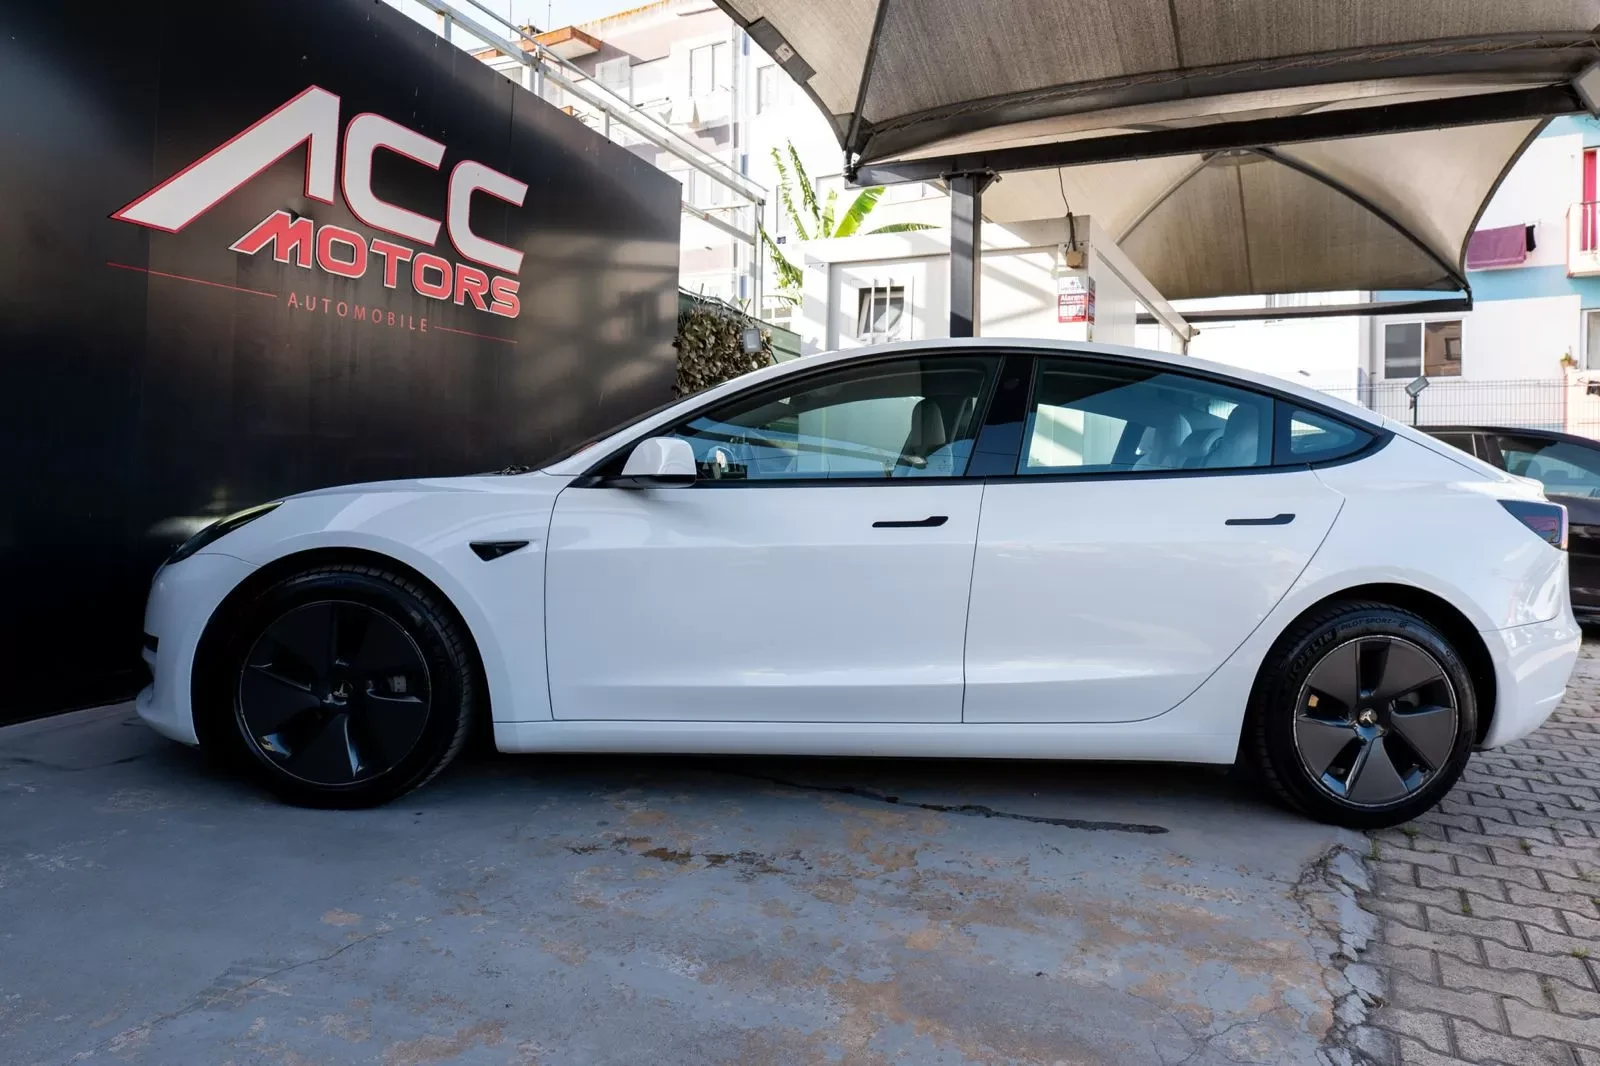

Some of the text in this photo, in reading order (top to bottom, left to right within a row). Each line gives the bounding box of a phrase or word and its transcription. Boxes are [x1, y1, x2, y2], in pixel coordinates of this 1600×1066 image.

[110, 85, 528, 275] ACC
[228, 209, 520, 319] MOTORS
[287, 291, 429, 332] AUTOMOBILE
